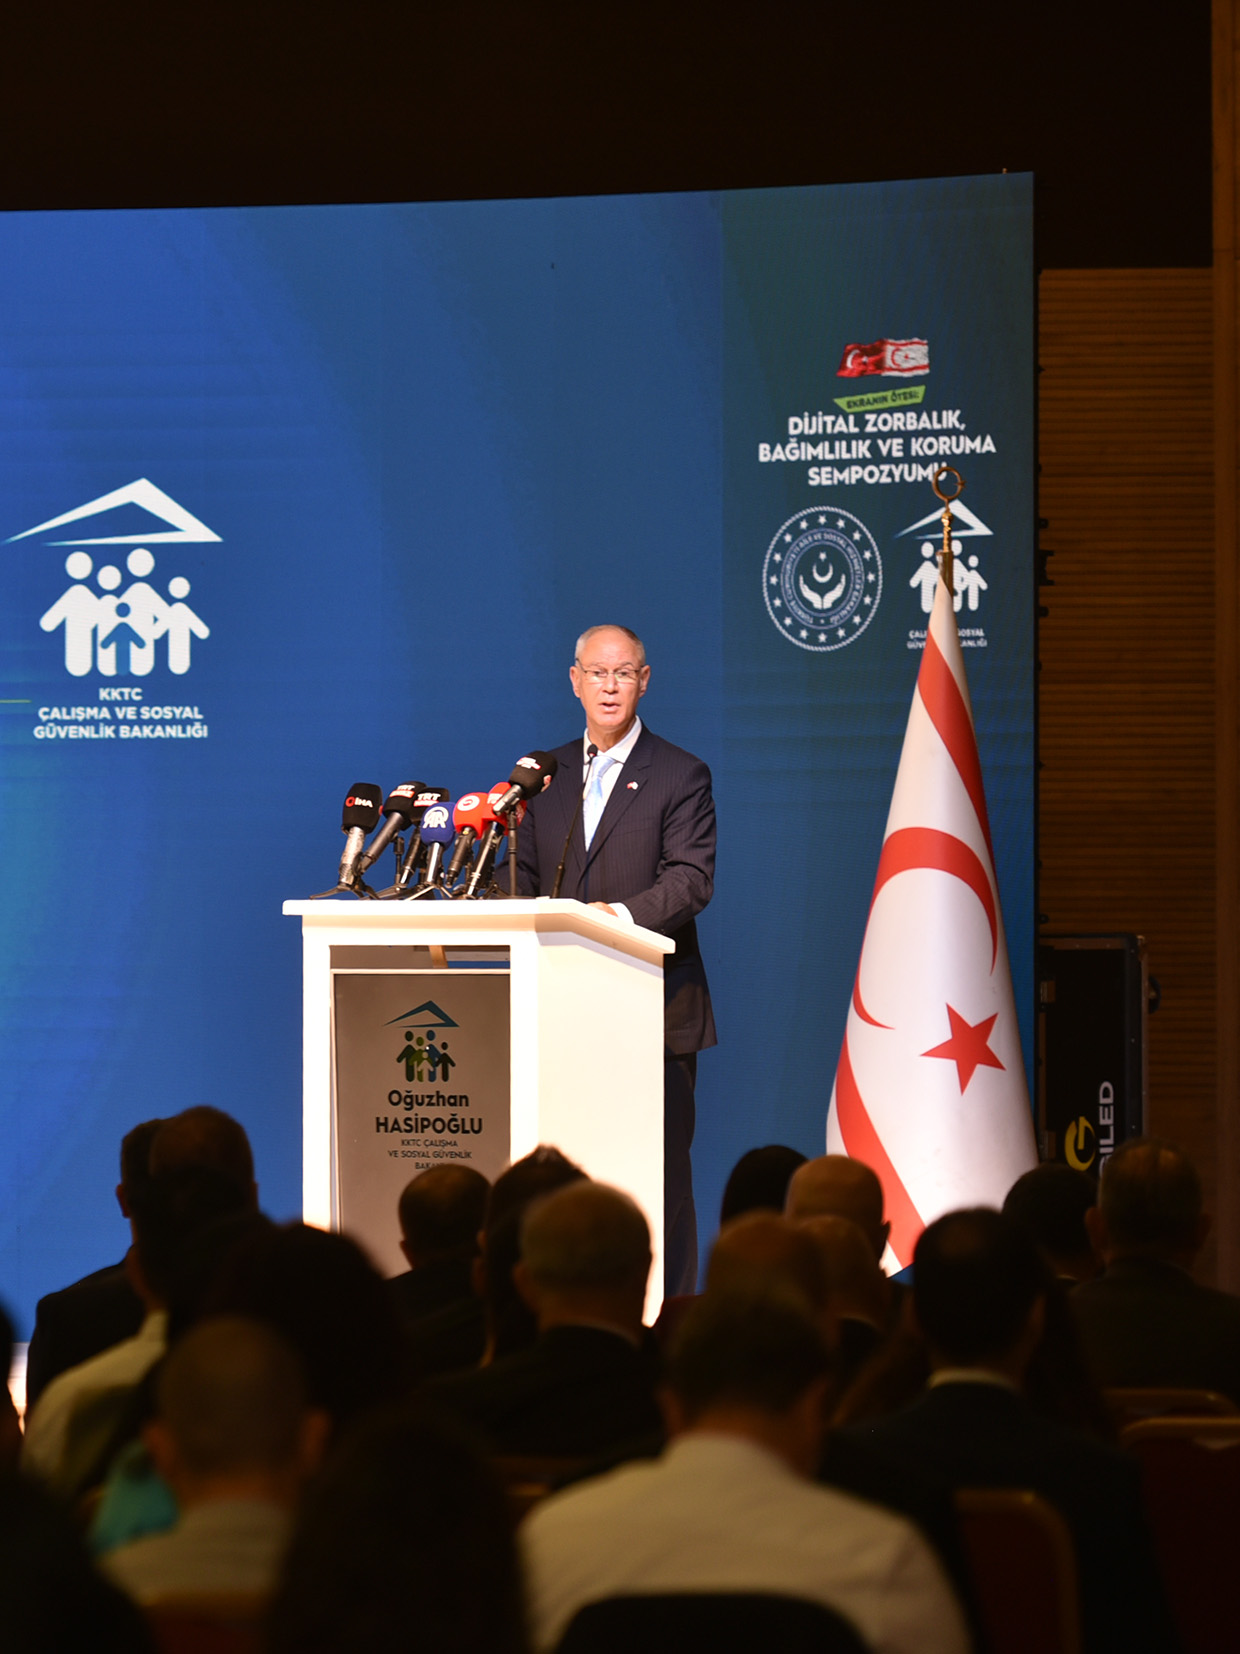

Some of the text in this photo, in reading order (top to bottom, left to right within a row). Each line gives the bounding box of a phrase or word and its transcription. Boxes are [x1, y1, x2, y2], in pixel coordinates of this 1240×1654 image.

[788, 409, 966, 436] DİJİTAL ZORBALIK,
[758, 434, 997, 463] BAĞIMLILIK VE KORUMA
[808, 461, 948, 486] SEMPOZYUMU
[99, 687, 143, 701] KKTC
[38, 706, 204, 722] ÇALIŞMA VE SOSYAL
[33, 721, 208, 739] GÜVENLİK BAKANLIĞI
[388, 1089, 469, 1111] Oğuzhan
[375, 1112, 483, 1135] HASİPOĞLU
[388, 1150, 399, 1158] VE
[401, 1150, 431, 1159] SOSYAL
